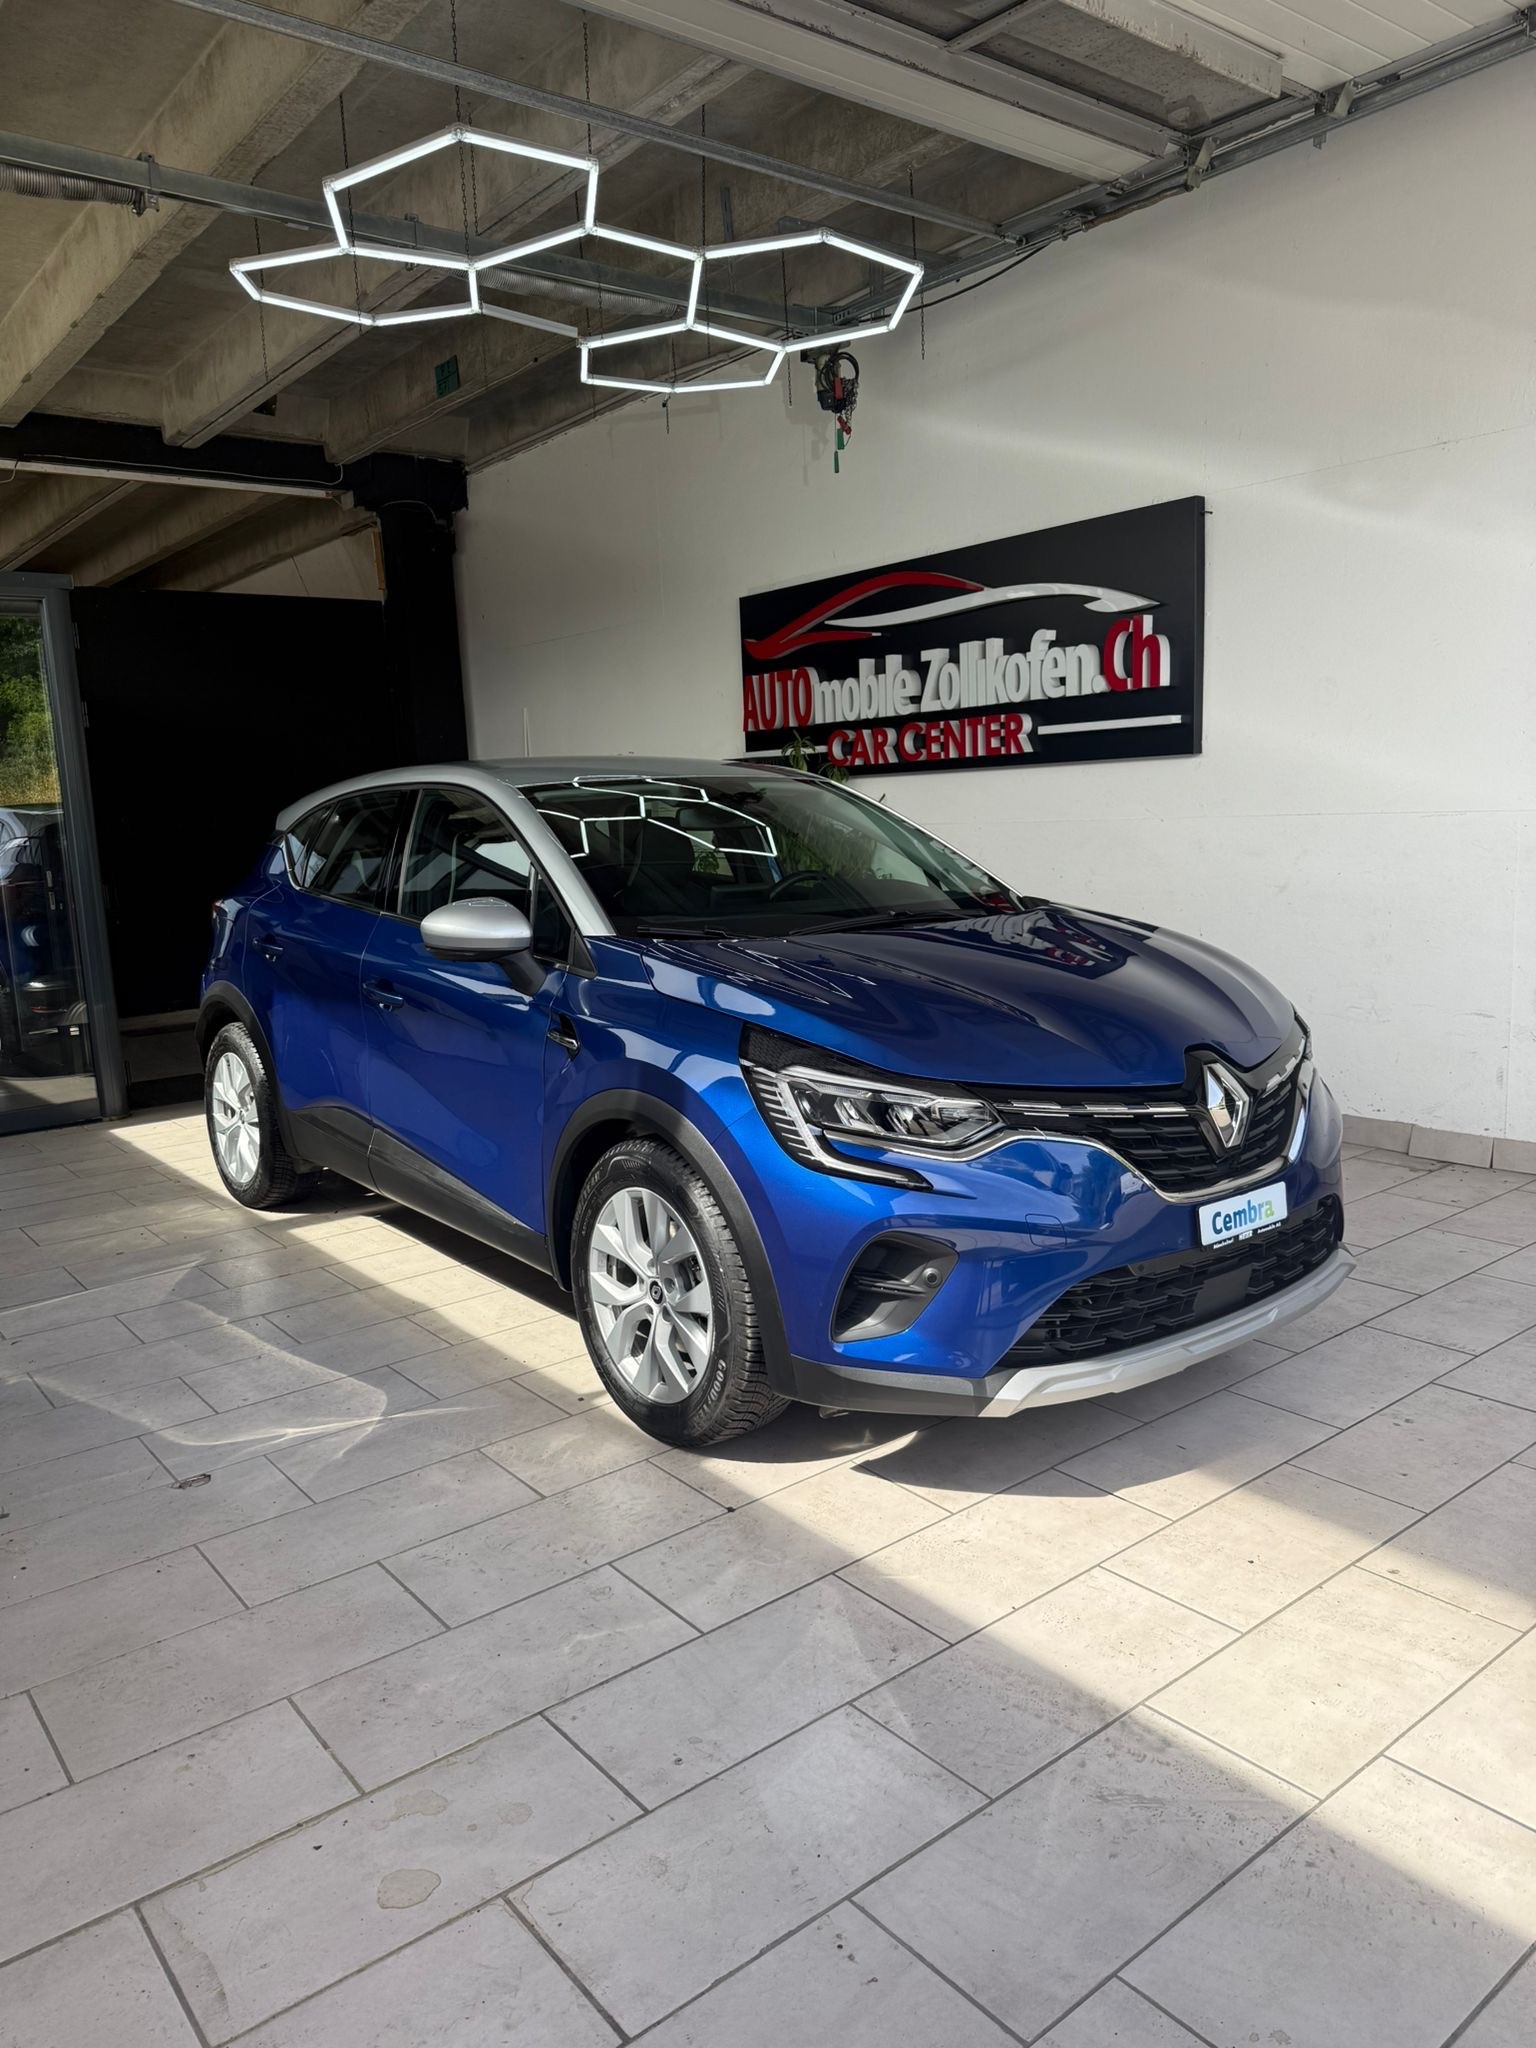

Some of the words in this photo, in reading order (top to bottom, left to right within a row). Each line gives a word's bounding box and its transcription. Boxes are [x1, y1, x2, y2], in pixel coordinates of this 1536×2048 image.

[828, 727, 899, 767] CAR
[899, 713, 1034, 763] CENTER
[1212, 1200, 1274, 1235] Cembra
